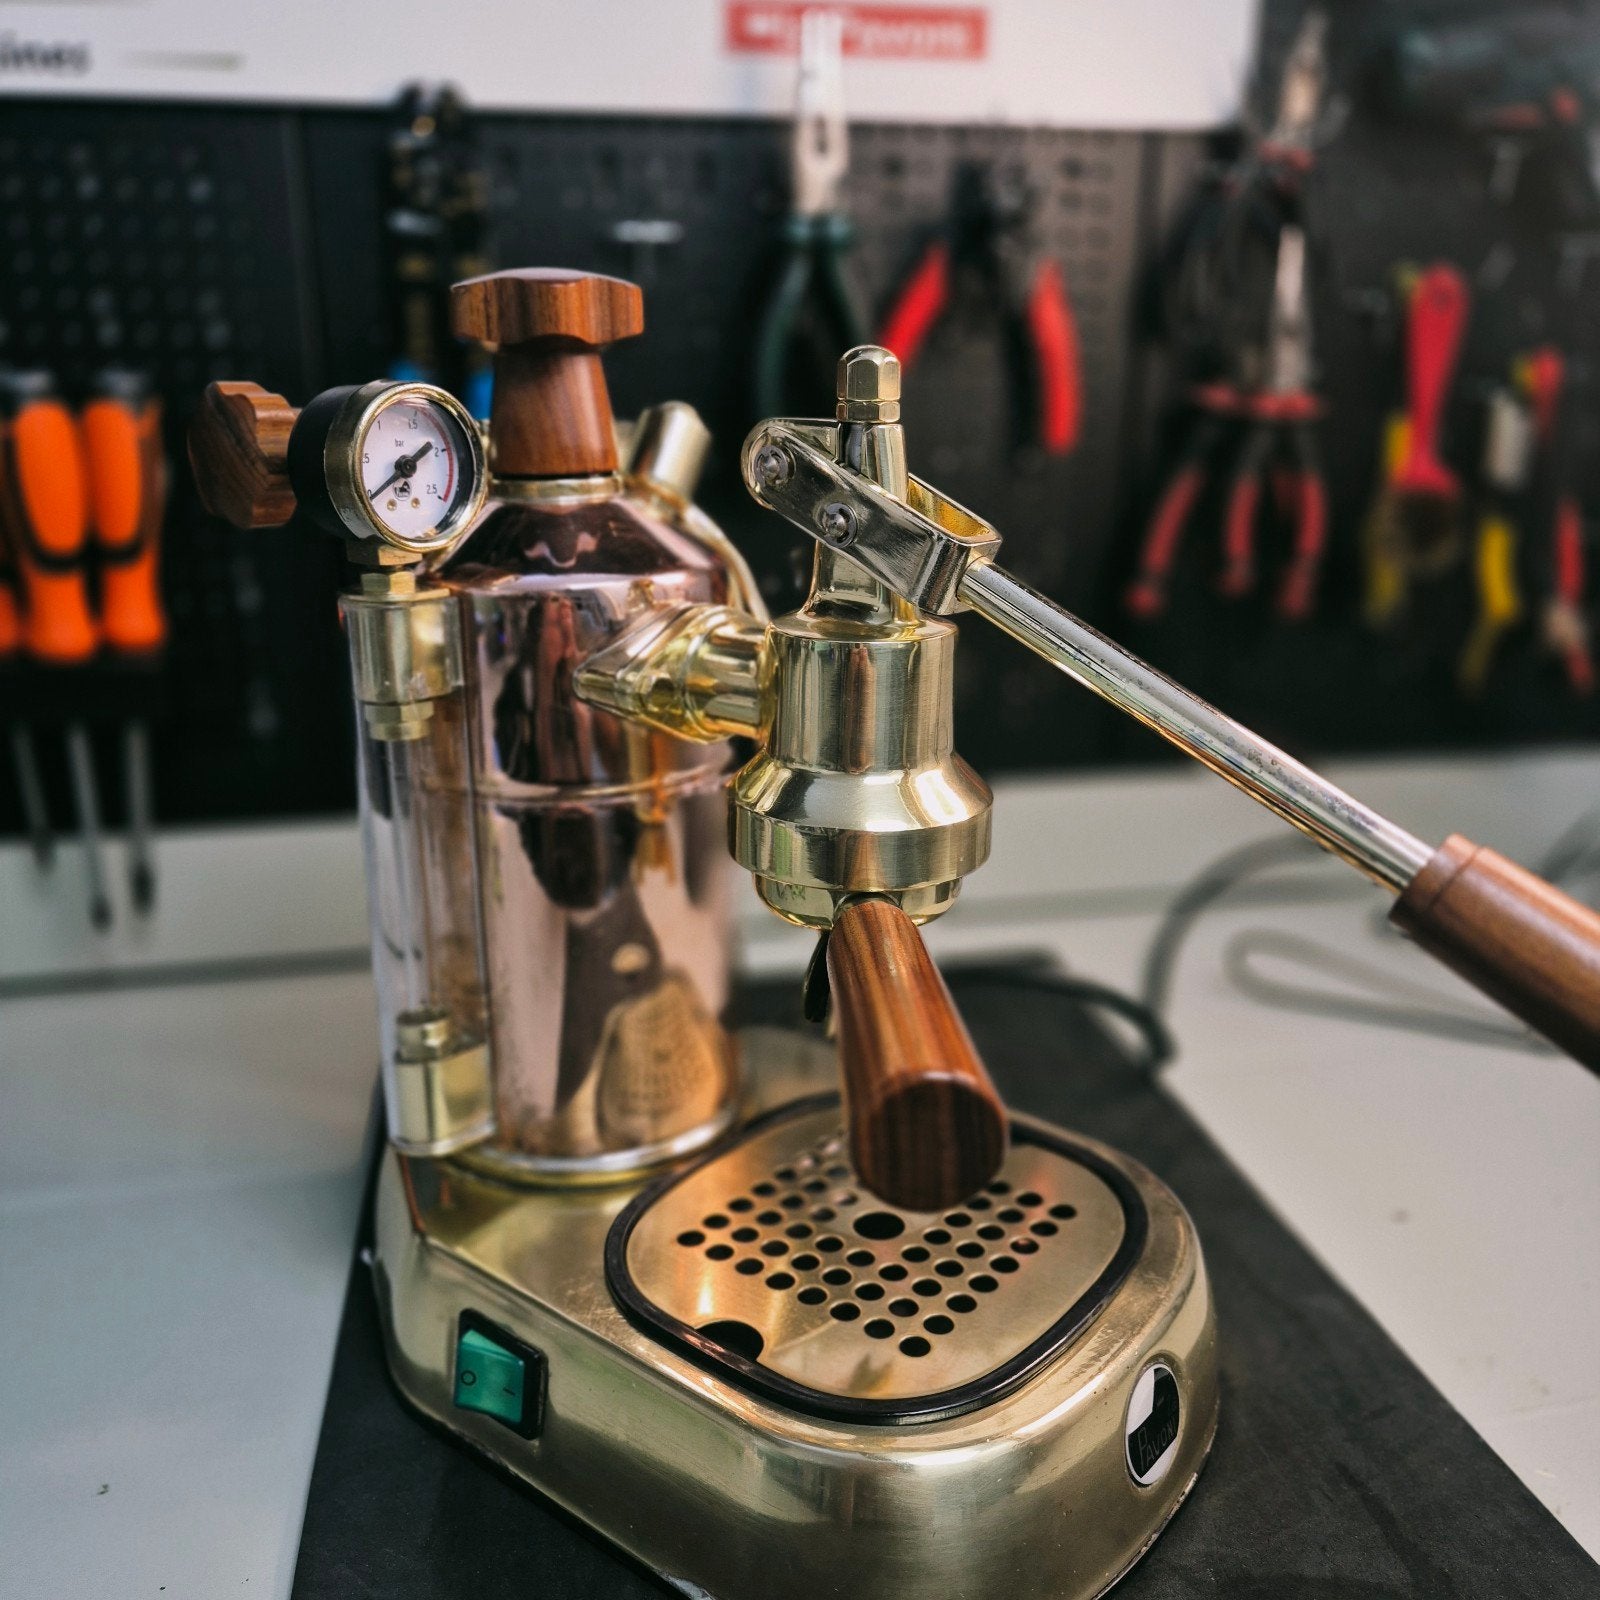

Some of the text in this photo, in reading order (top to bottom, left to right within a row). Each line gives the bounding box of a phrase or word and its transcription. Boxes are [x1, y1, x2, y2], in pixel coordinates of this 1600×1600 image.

[377, 419, 381, 430] 1
[394, 438, 404, 448] bar
[434, 447, 439, 458] 2
[426, 484, 438, 495] 2.5
